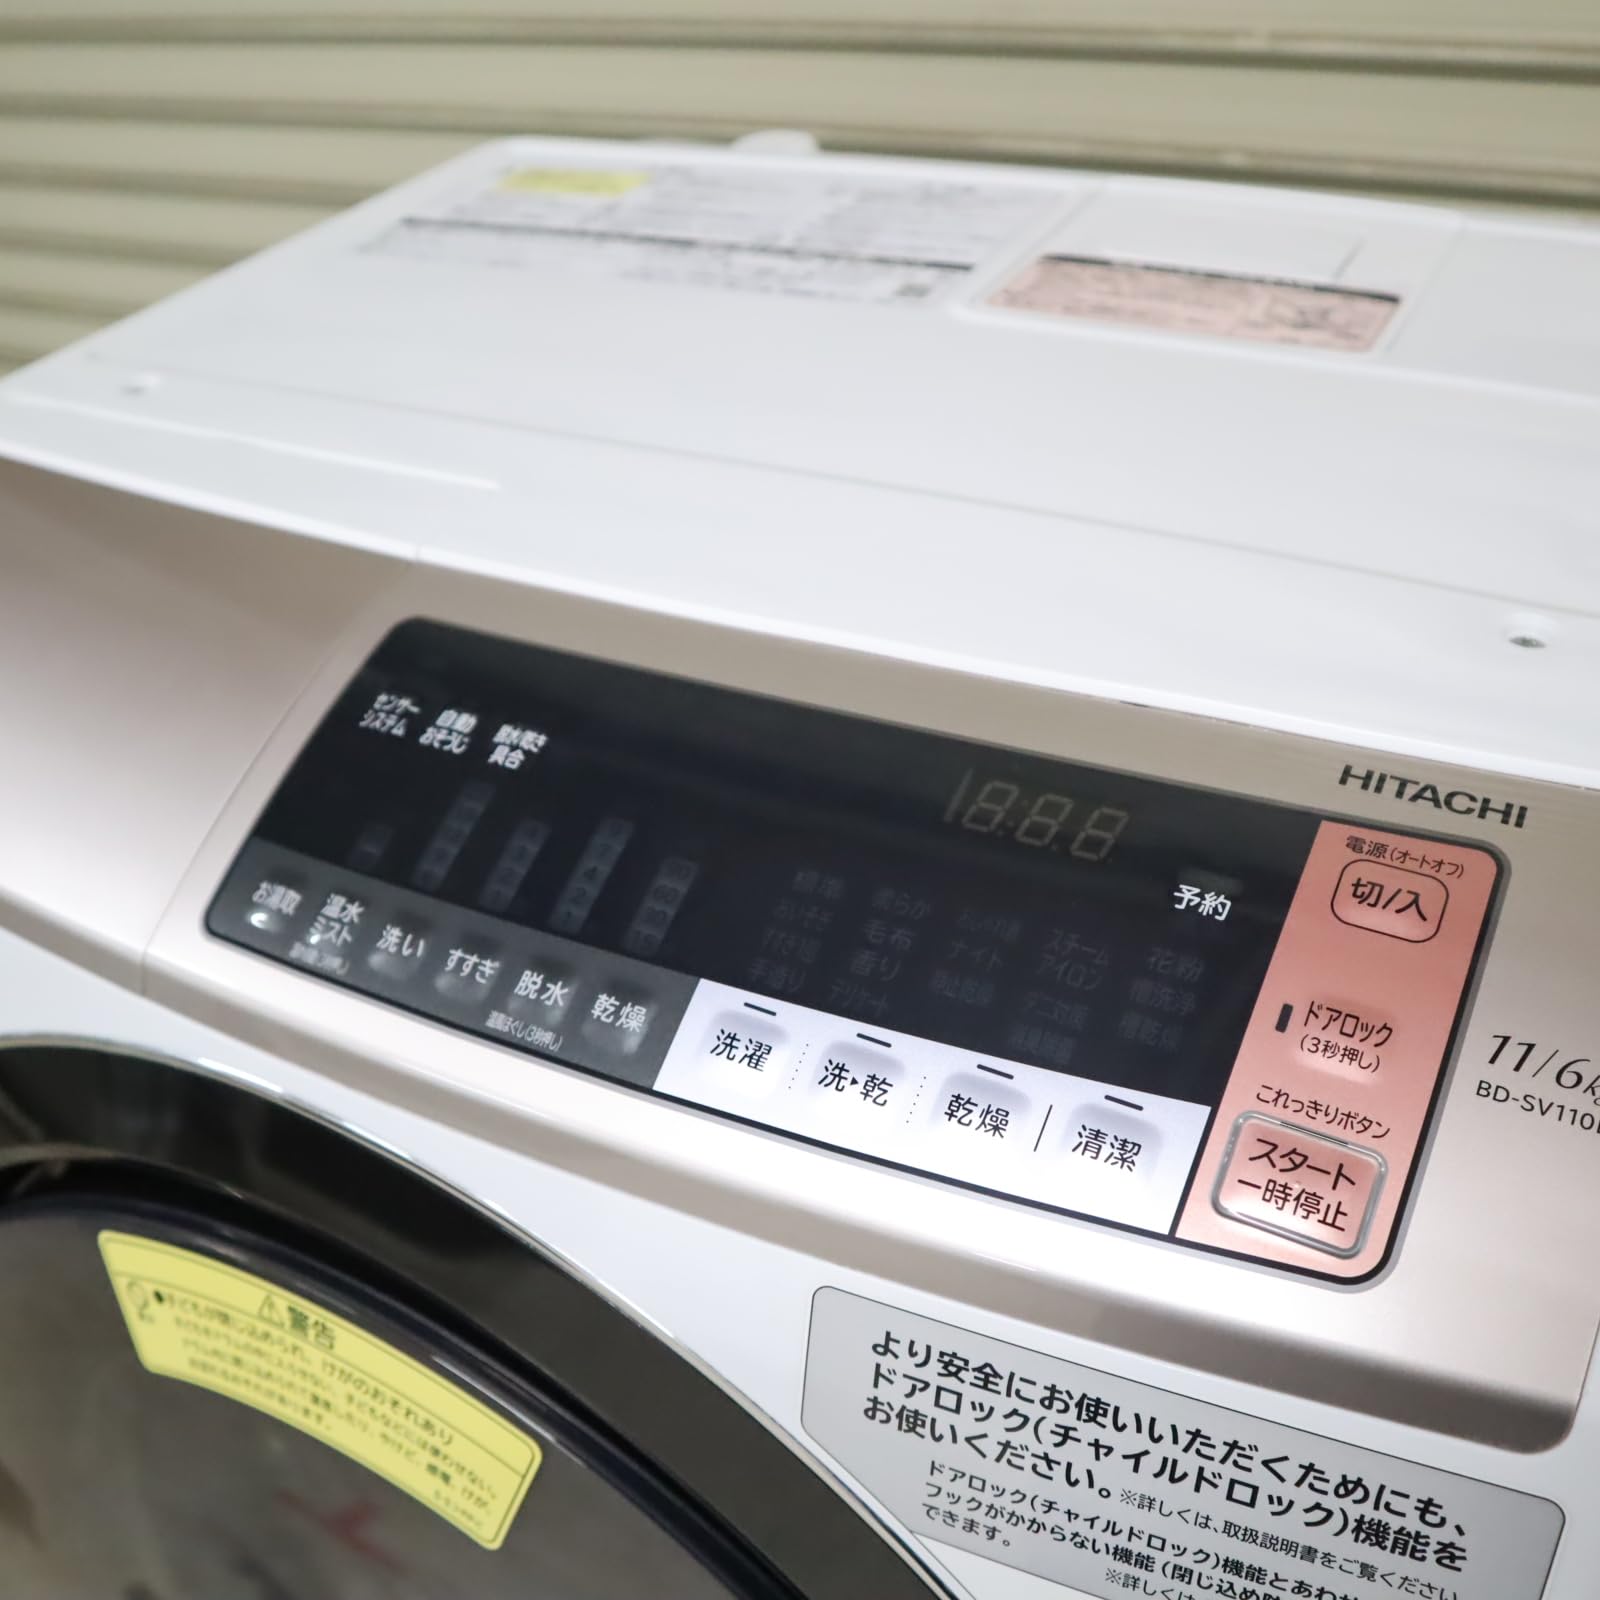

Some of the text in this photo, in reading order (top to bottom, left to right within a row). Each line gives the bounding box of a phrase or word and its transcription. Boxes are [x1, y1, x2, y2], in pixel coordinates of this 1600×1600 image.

[1338, 764, 1529, 829] HITACHI
[1345, 835, 1465, 879] 電源(オートオフ)
[1173, 884, 1232, 922] 予約
[1351, 877, 1428, 922] 切/入
[376, 923, 426, 959] 洗い
[445, 948, 500, 984] すすぎ
[514, 970, 569, 1008] 脱水
[590, 992, 648, 1034] 乾燥
[1304, 1001, 1394, 1048] ドアロック
[709, 1028, 774, 1073] 洗濯
[1300, 1035, 1381, 1075] (3秒押し)
[944, 1092, 1011, 1139] 乾燥
[1256, 1083, 1391, 1141] これっきりボタン
[1476, 1080, 1600, 1134] BD-SV110
[1071, 1124, 1143, 1174] 清潔
[1247, 1138, 1357, 1189] スタート
[1237, 1176, 1349, 1233] 一時停止
[863, 1396, 1112, 1499] お使いください。
[871, 1330, 1466, 1537] より安全にお使いいただくためにも、
[872, 1363, 1468, 1572] ドアロック(チャイルドロック)機能を
[922, 1503, 1011, 1548] できます。
[925, 1481, 1281, 1600] フックがかからない機能(閉じ込め
